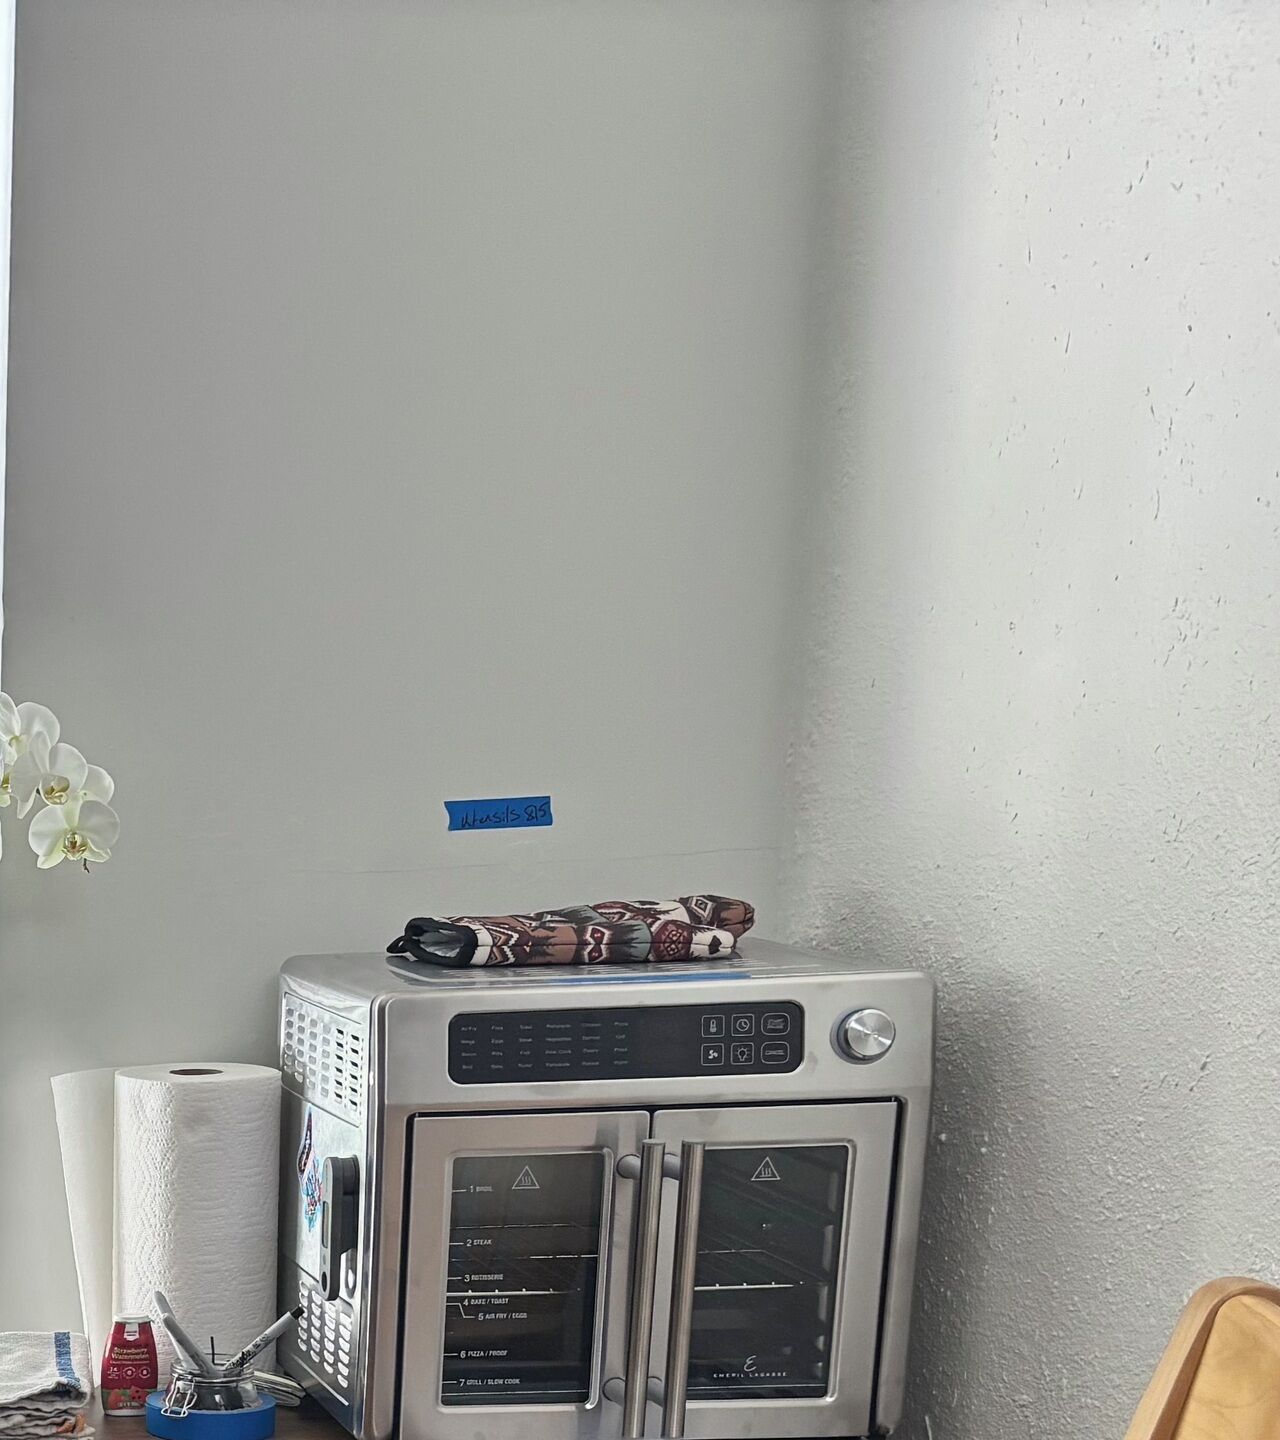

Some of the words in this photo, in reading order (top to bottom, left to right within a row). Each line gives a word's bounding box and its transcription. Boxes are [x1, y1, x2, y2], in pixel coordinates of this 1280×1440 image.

[464, 1274, 470, 1282] 3
[460, 1350, 466, 1358] 6
[459, 1379, 465, 1387] 7
